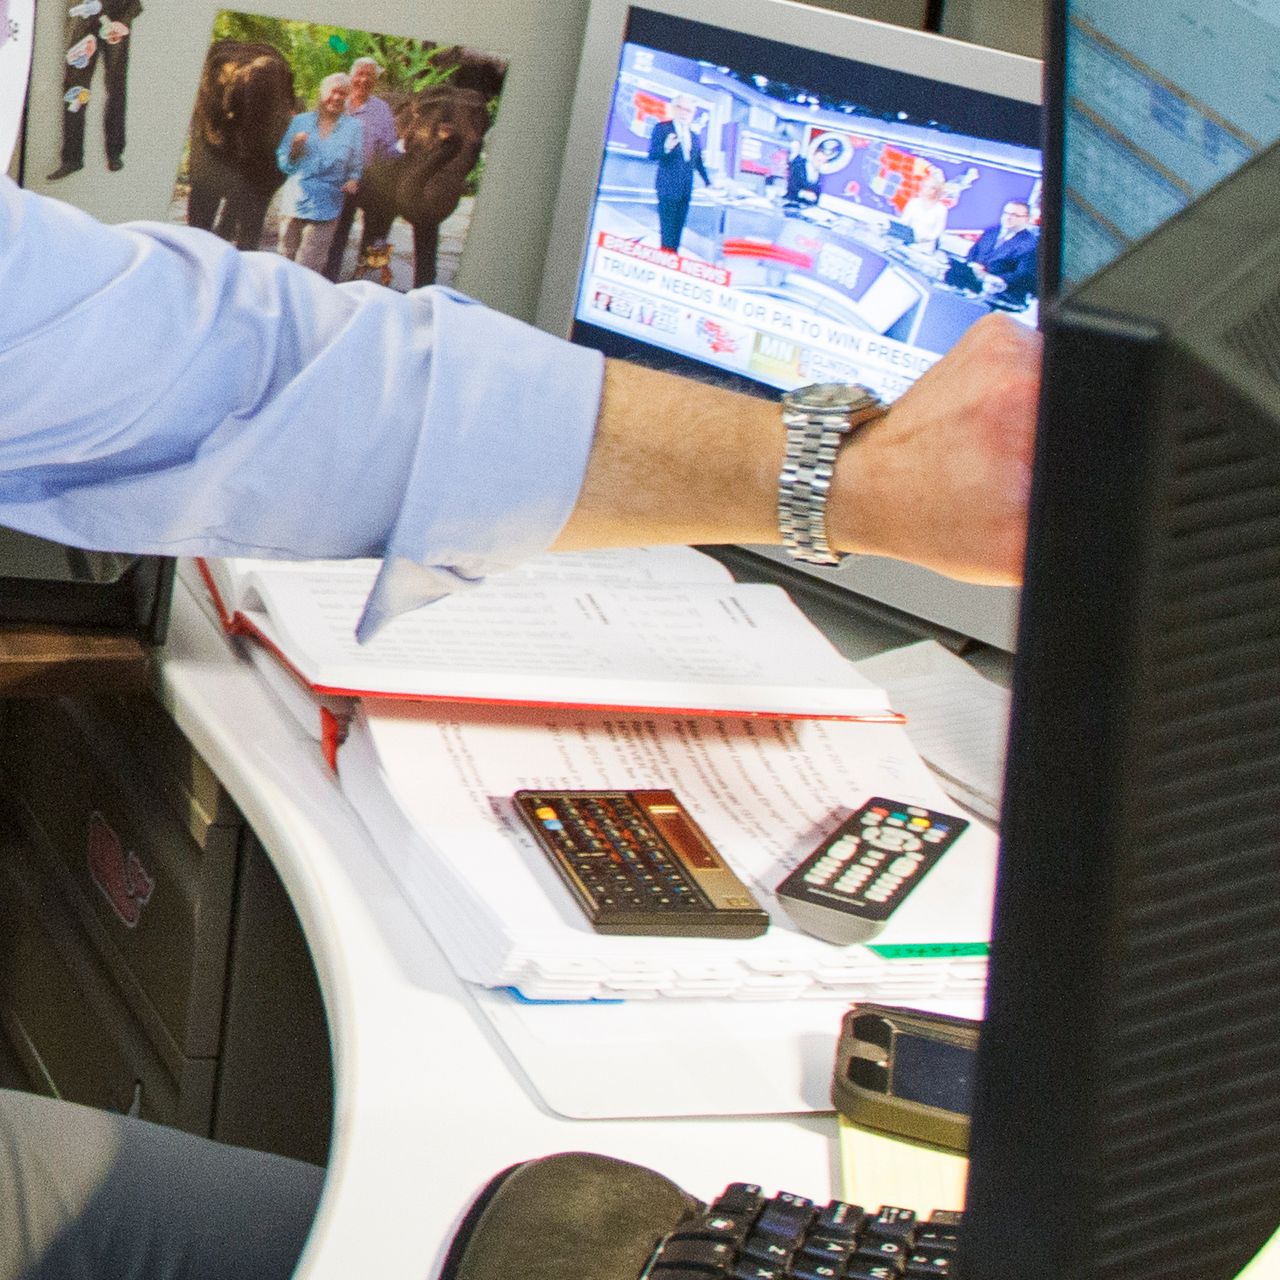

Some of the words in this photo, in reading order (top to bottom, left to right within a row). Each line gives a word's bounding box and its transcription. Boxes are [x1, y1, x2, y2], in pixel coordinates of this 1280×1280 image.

[602, 234, 679, 269] BREAKING
[681, 257, 727, 284] NEWS
[602, 255, 656, 282] TRUMP
[661, 274, 713, 303] NEEDS
[719, 292, 739, 312] MI
[742, 301, 766, 320] OR
[772, 311, 794, 329] PA
[800, 319, 822, 340] TO
[827, 326, 862, 353] WIN
